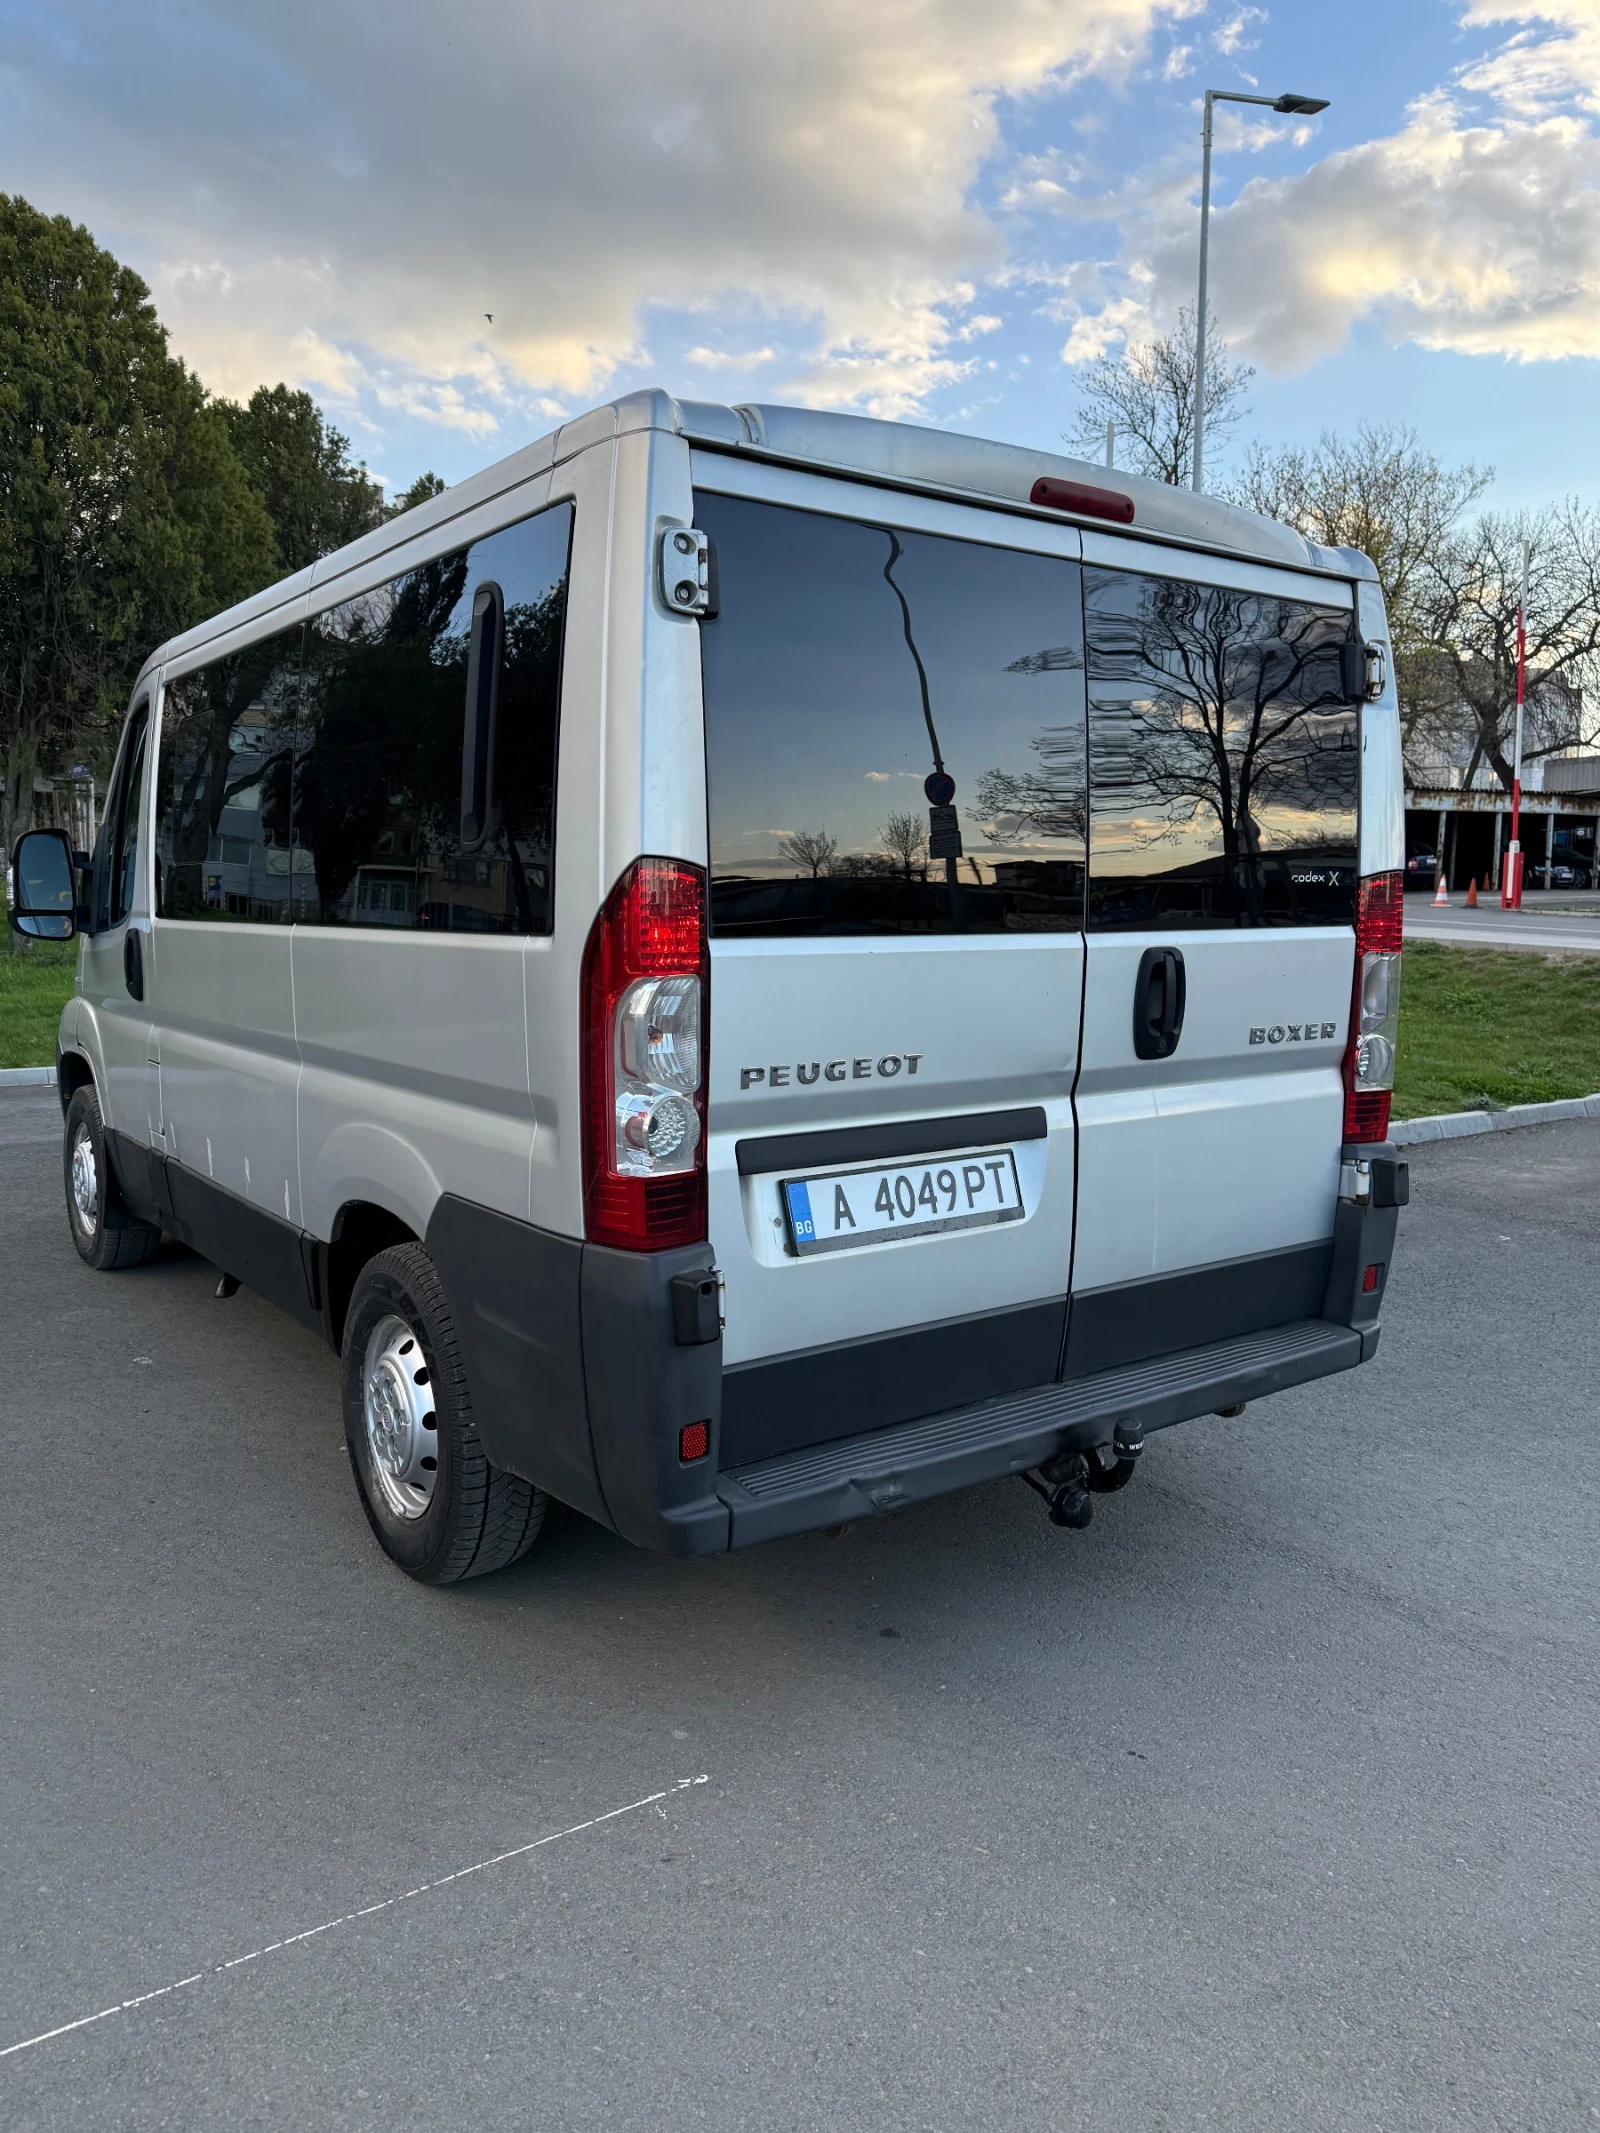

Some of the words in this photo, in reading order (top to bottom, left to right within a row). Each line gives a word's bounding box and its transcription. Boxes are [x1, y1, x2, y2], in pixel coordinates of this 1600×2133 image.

[1291, 870, 1326, 883] codex
[1328, 870, 1340, 887] X
[1249, 1022, 1337, 1045] BOXER
[740, 1053, 924, 1090] PEUGEOT
[834, 1184, 857, 1230] A
[795, 1220, 813, 1235] BG
